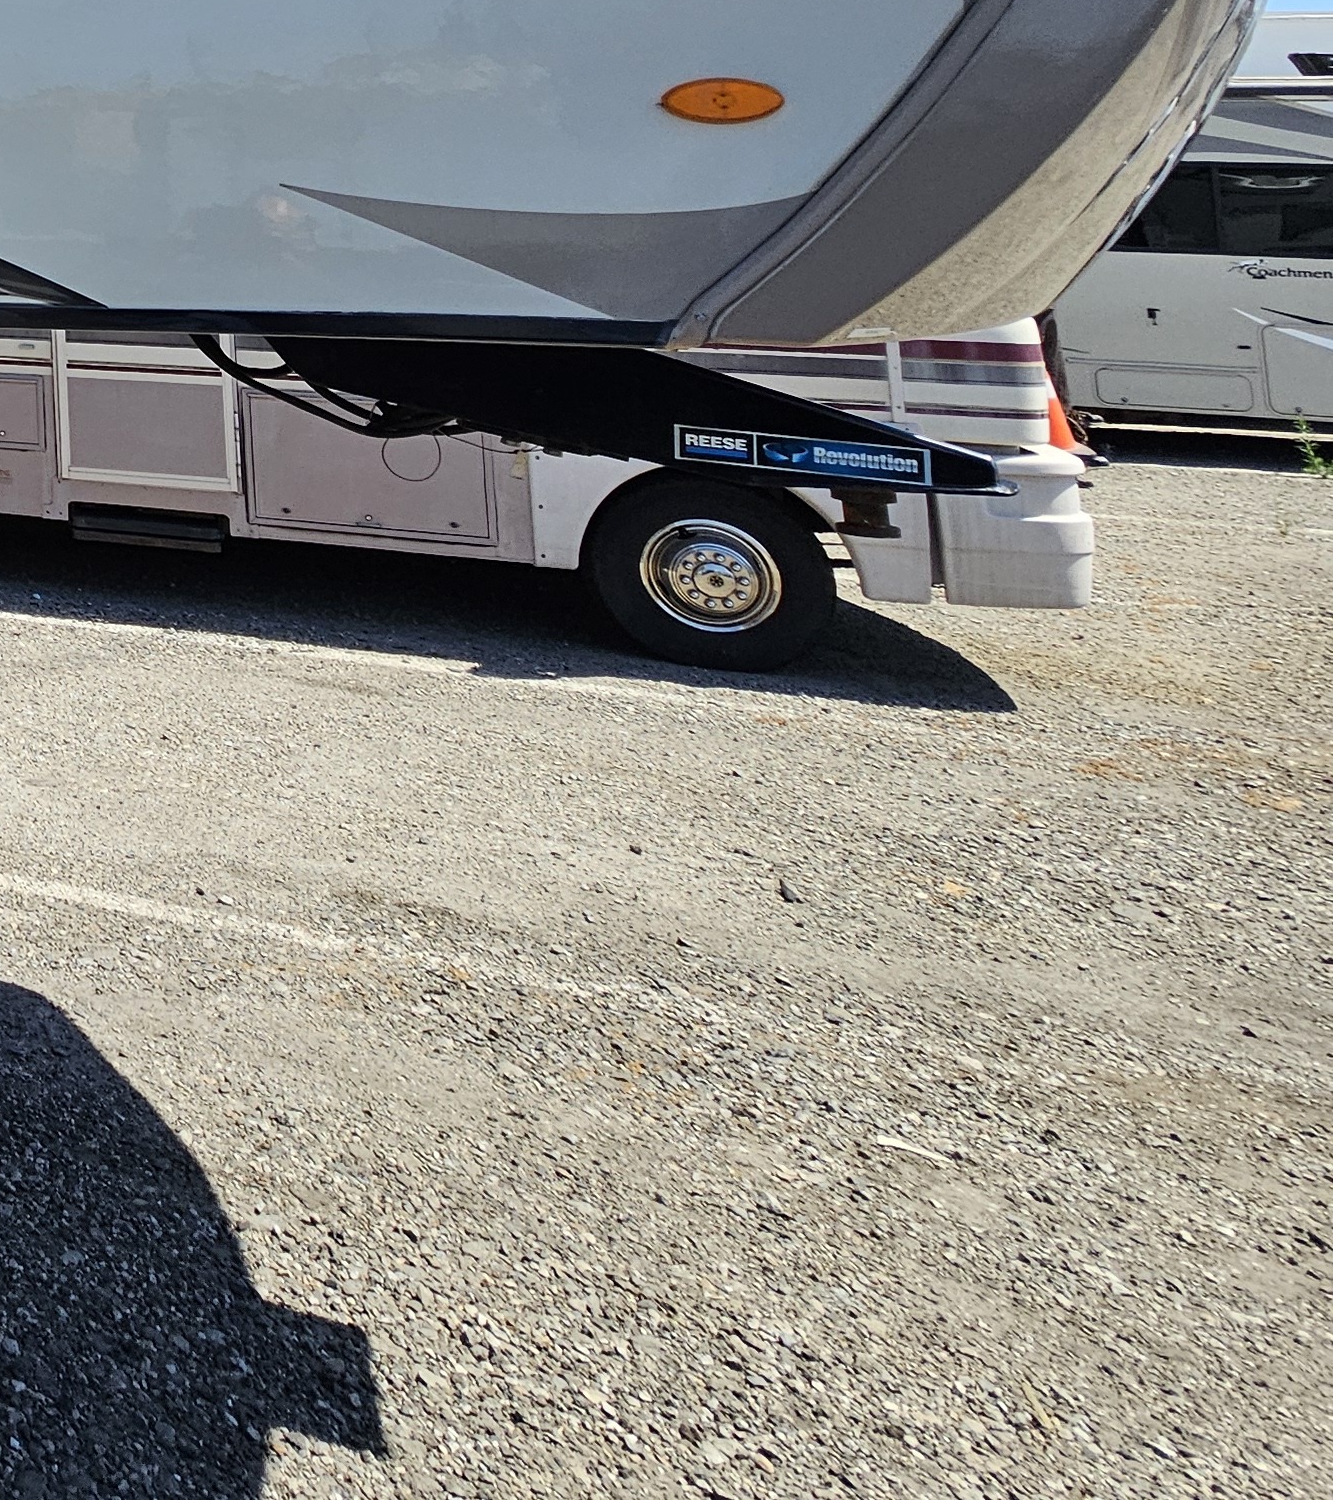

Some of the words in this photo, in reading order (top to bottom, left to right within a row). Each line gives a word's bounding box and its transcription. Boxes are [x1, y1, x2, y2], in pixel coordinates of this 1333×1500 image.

[1245, 266, 1333, 279] Coachmen
[685, 432, 748, 452] REESE
[813, 446, 919, 474] Revolution
